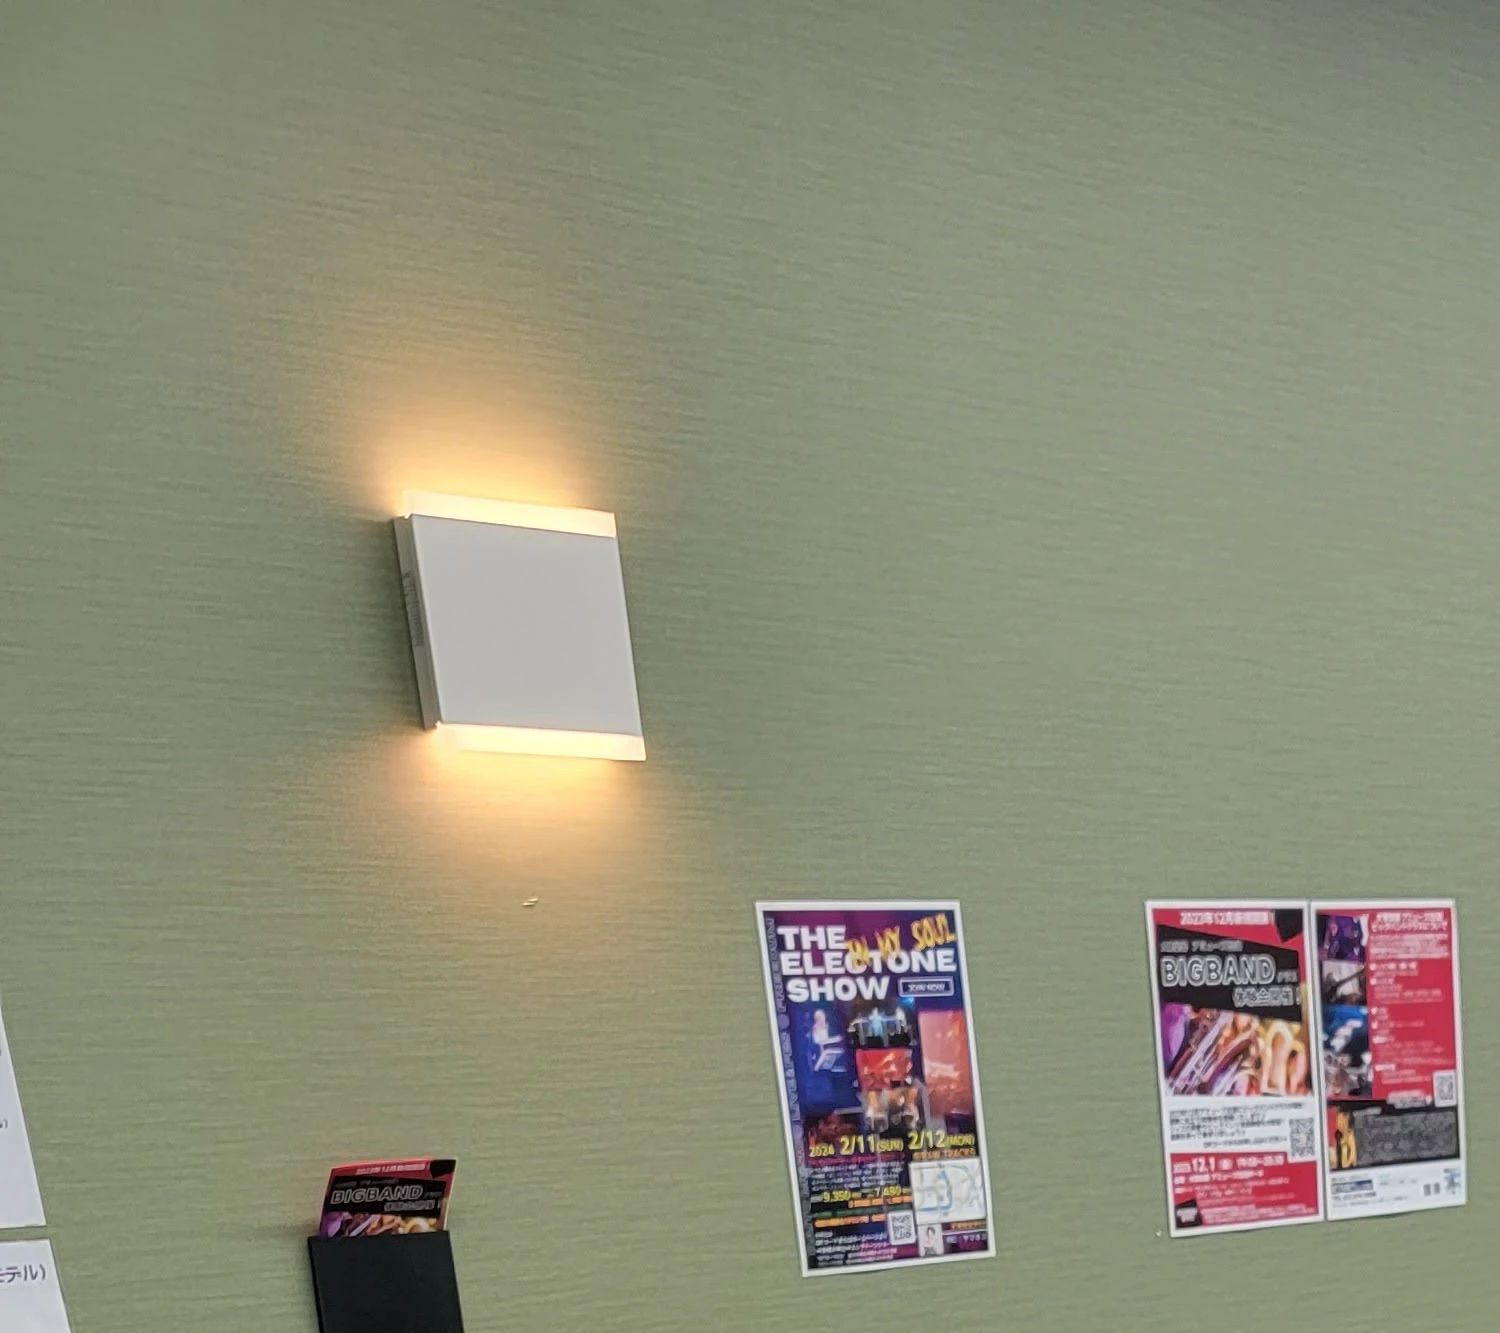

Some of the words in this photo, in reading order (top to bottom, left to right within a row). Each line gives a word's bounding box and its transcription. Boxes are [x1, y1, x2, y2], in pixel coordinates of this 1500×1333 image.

[777, 925, 846, 950] THE
[779, 949, 957, 976] ELECTONE
[1159, 954, 1276, 987] BIGBAND
[785, 975, 890, 1003] SHOW
[330, 1184, 423, 1205] BIGBAND
